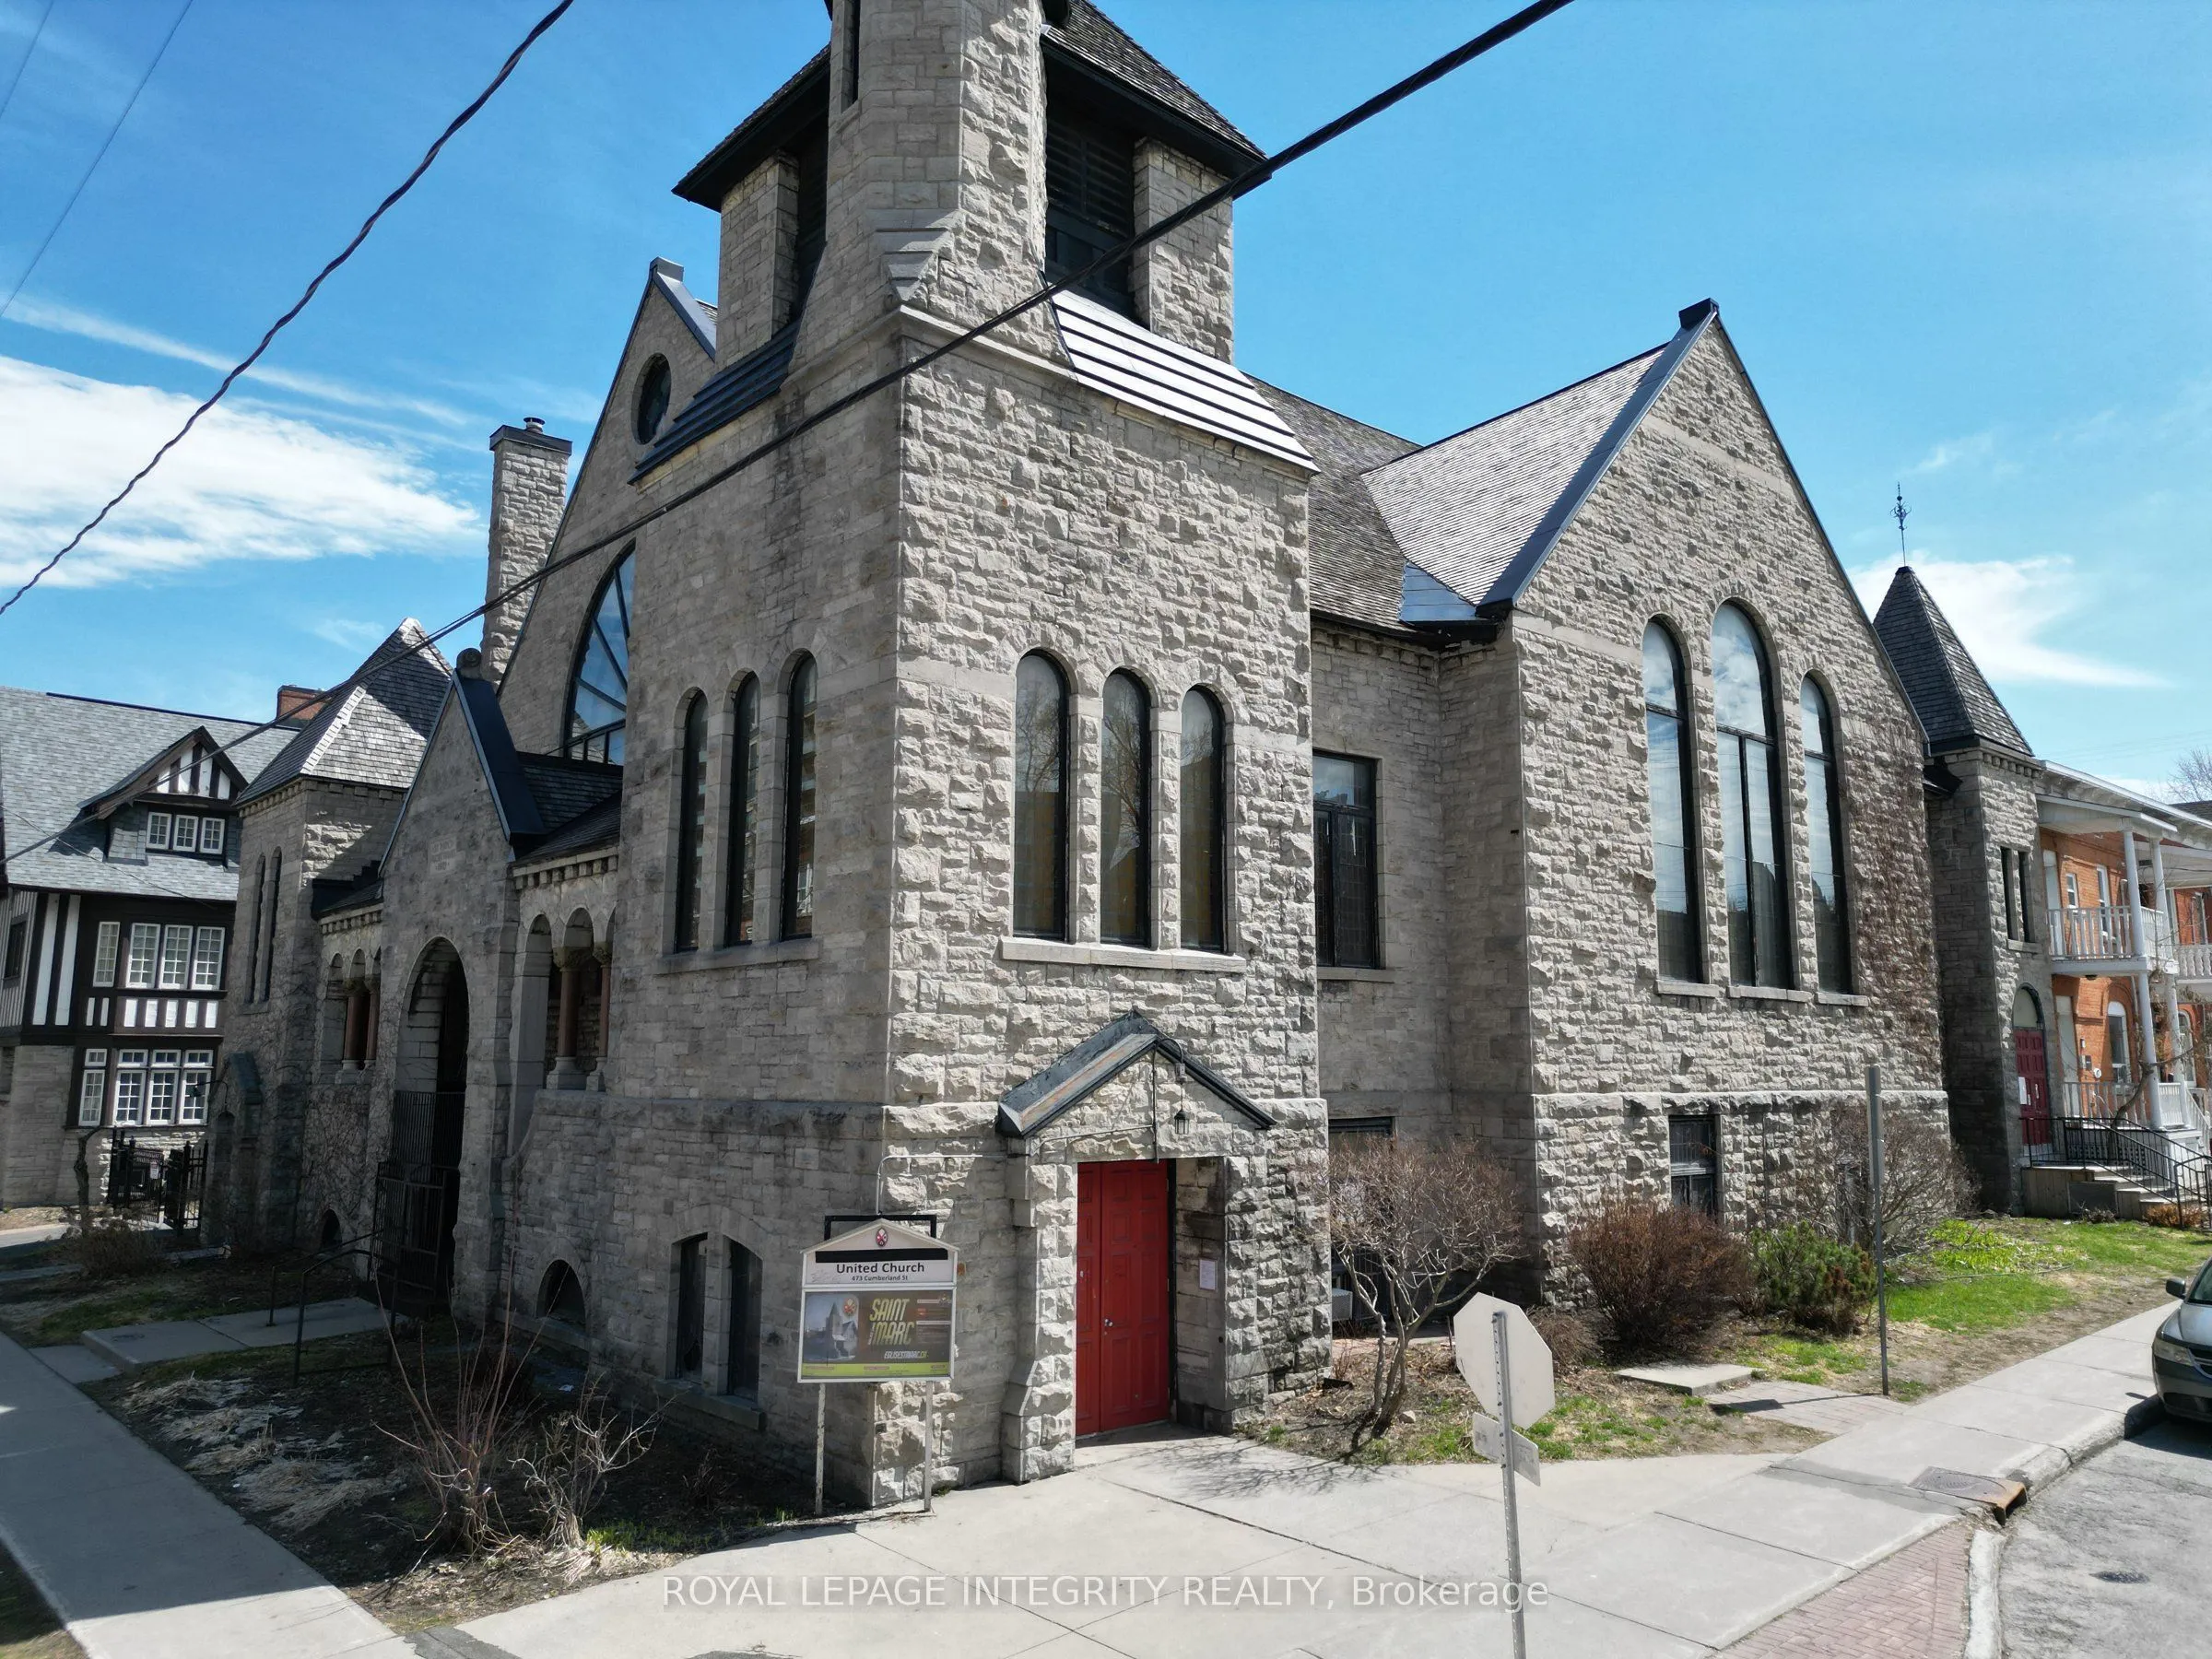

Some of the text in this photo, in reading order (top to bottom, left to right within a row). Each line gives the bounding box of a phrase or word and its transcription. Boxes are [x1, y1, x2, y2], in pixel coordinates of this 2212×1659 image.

[836, 1262, 924, 1274] United Church
[869, 1298, 910, 1321] SAINT
[872, 1321, 915, 1346] MARC
